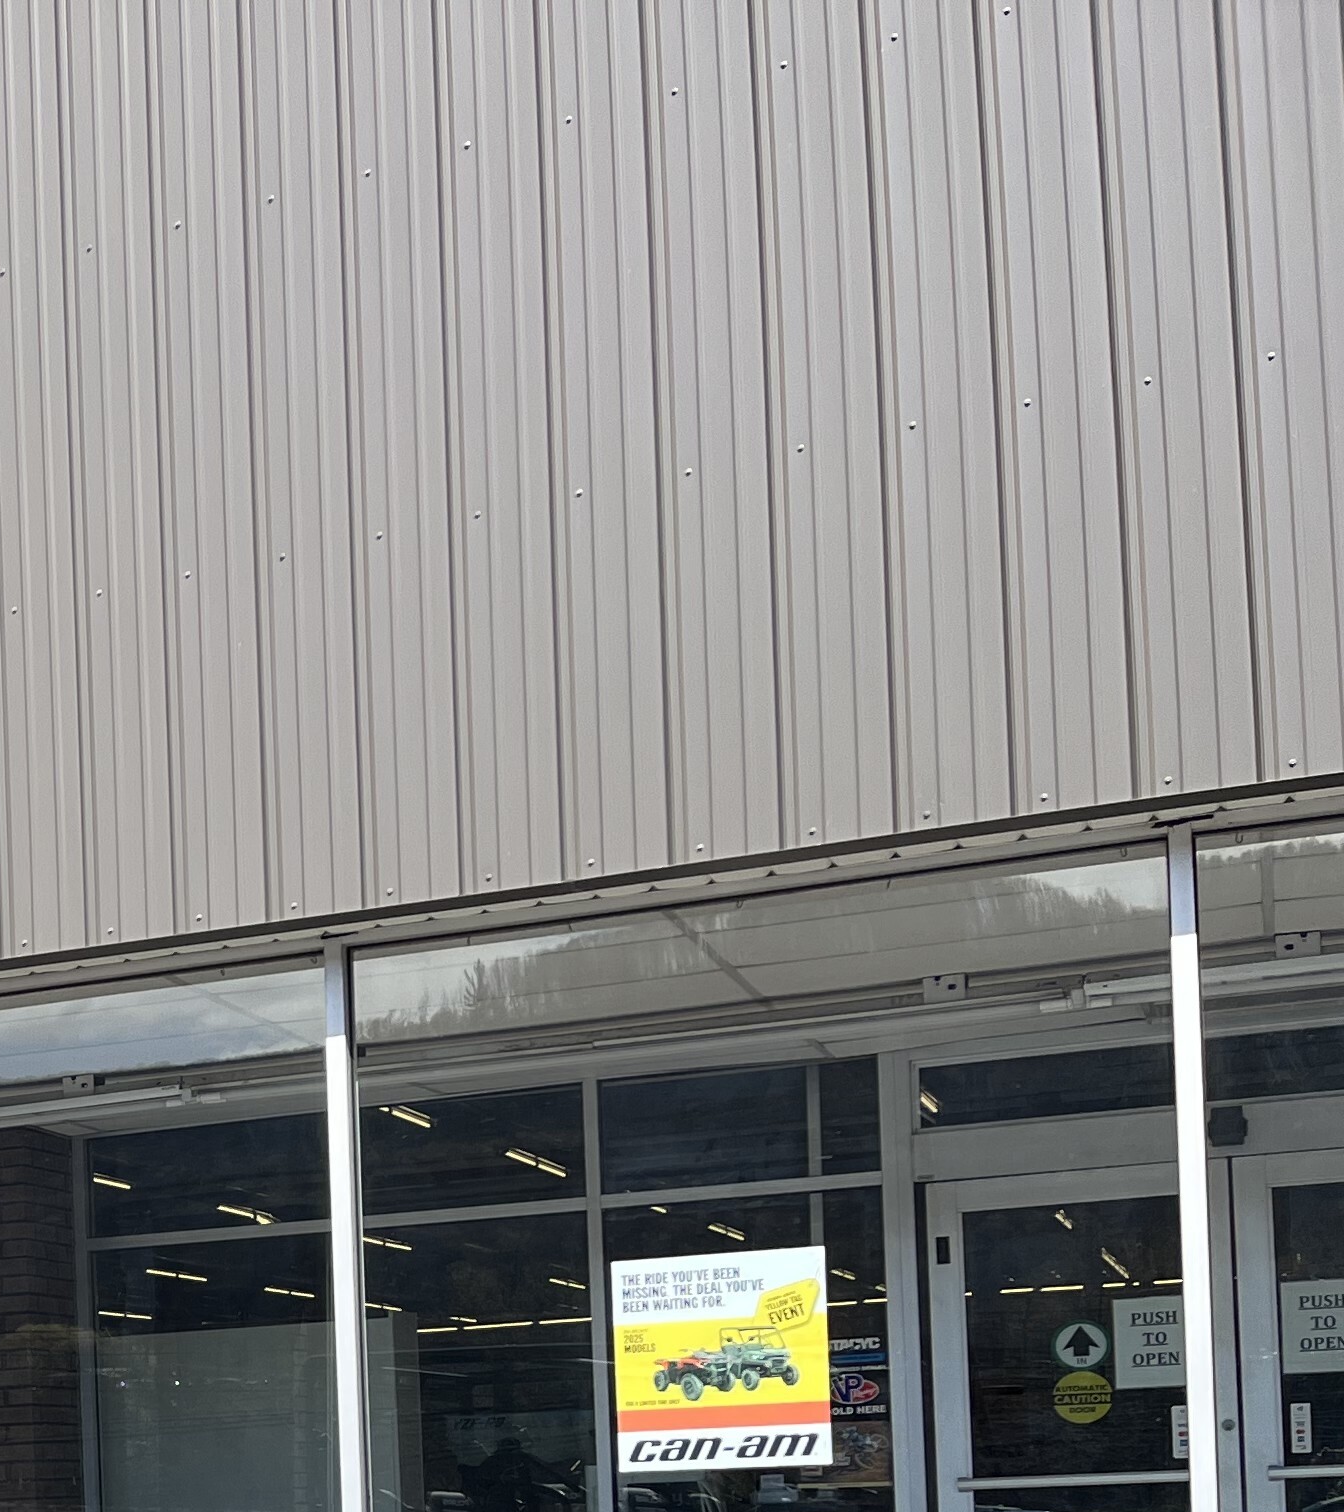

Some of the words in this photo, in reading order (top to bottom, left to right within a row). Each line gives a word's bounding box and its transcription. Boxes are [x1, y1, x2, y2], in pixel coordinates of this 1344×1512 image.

[621, 1274, 641, 1286] THE
[644, 1272, 669, 1285] RIDE
[671, 1269, 709, 1283] YOU'VE
[712, 1267, 741, 1280] BEEN
[672, 1284, 693, 1296] THE
[696, 1282, 723, 1295] DEAL
[726, 1279, 765, 1293] YOU'VE
[622, 1300, 650, 1313] BEEN
[652, 1297, 699, 1311] WAITING
[768, 1303, 805, 1324] EVENT
[1130, 1310, 1178, 1326] PUSH
[1310, 1315, 1337, 1330] TO
[624, 1334, 644, 1344] 2025
[1142, 1331, 1168, 1346] TO
[624, 1343, 656, 1354] MODELS
[1076, 1357, 1087, 1365] IN
[1132, 1351, 1181, 1367] OPEN
[1055, 1384, 1108, 1393] AUTOMATIC
[1054, 1394, 1111, 1405] CAUTION
[831, 1406, 854, 1416] OLD
[856, 1404, 887, 1415] HERE
[1069, 1406, 1096, 1414] DOOR
[629, 1432, 819, 1463] can-am
